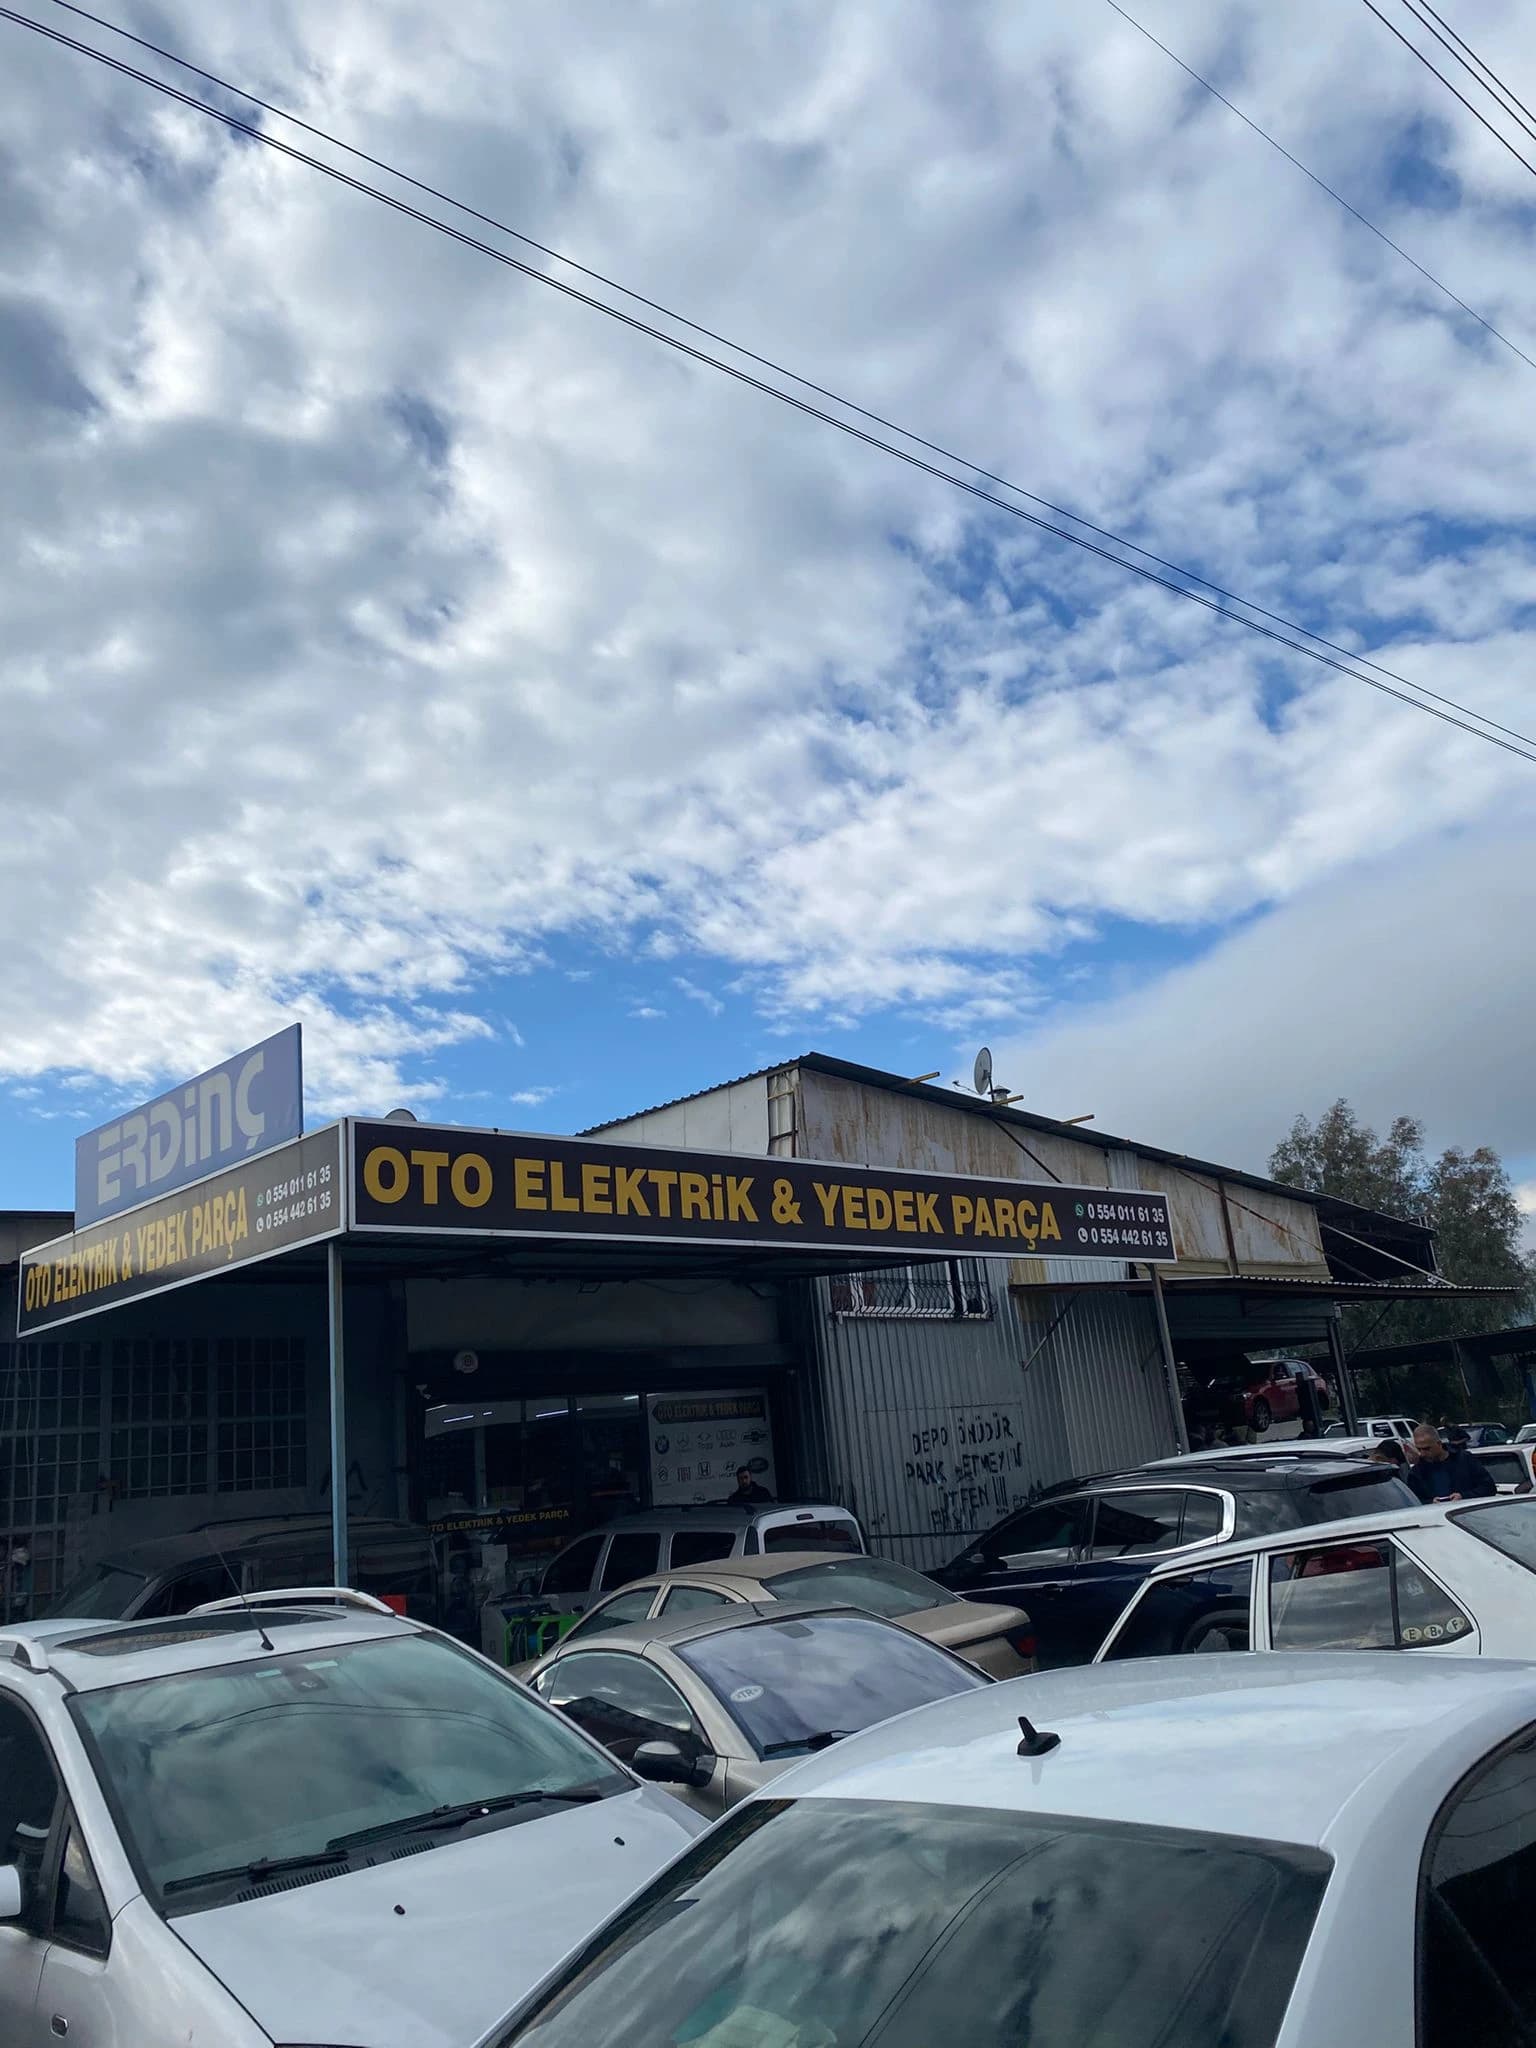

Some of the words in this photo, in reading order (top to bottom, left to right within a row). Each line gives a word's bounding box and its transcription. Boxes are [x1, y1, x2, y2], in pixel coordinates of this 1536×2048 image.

[266, 1189, 272, 1205] 0
[273, 1182, 288, 1202] 554
[289, 1175, 305, 1196] 011
[307, 1170, 317, 1189] 61
[319, 1164, 331, 1184] 35
[363, 1146, 494, 1208] OTO
[771, 1178, 804, 1225] &
[812, 1182, 945, 1235] YEDEK
[952, 1195, 1062, 1251] PARÇA
[266, 1213, 272, 1230] 0
[273, 1207, 288, 1227] 554
[289, 1200, 306, 1220] 442
[307, 1195, 317, 1215] 61
[319, 1190, 331, 1210] 35
[1088, 1203, 1095, 1220] 0
[1097, 1204, 1116, 1221] 554
[1117, 1205, 1136, 1222] 011
[1138, 1206, 1150, 1223] 61
[1152, 1207, 1165, 1224] 35
[25, 1261, 50, 1312] OTO
[121, 1231, 132, 1282] &
[137, 1210, 189, 1274] YEDEK
[191, 1186, 249, 1260] PARÇA
[1091, 1227, 1098, 1244] 0
[1100, 1228, 1119, 1244] 554
[1121, 1228, 1140, 1245] 442
[1141, 1230, 1153, 1246] 61
[1155, 1230, 1168, 1247] 35
[912, 1427, 948, 1455] DEPO
[906, 1460, 947, 1485] PARK
[1408, 1629, 1416, 1640] E
[1430, 1626, 1438, 1637] B
[1451, 1619, 1458, 1630] F
